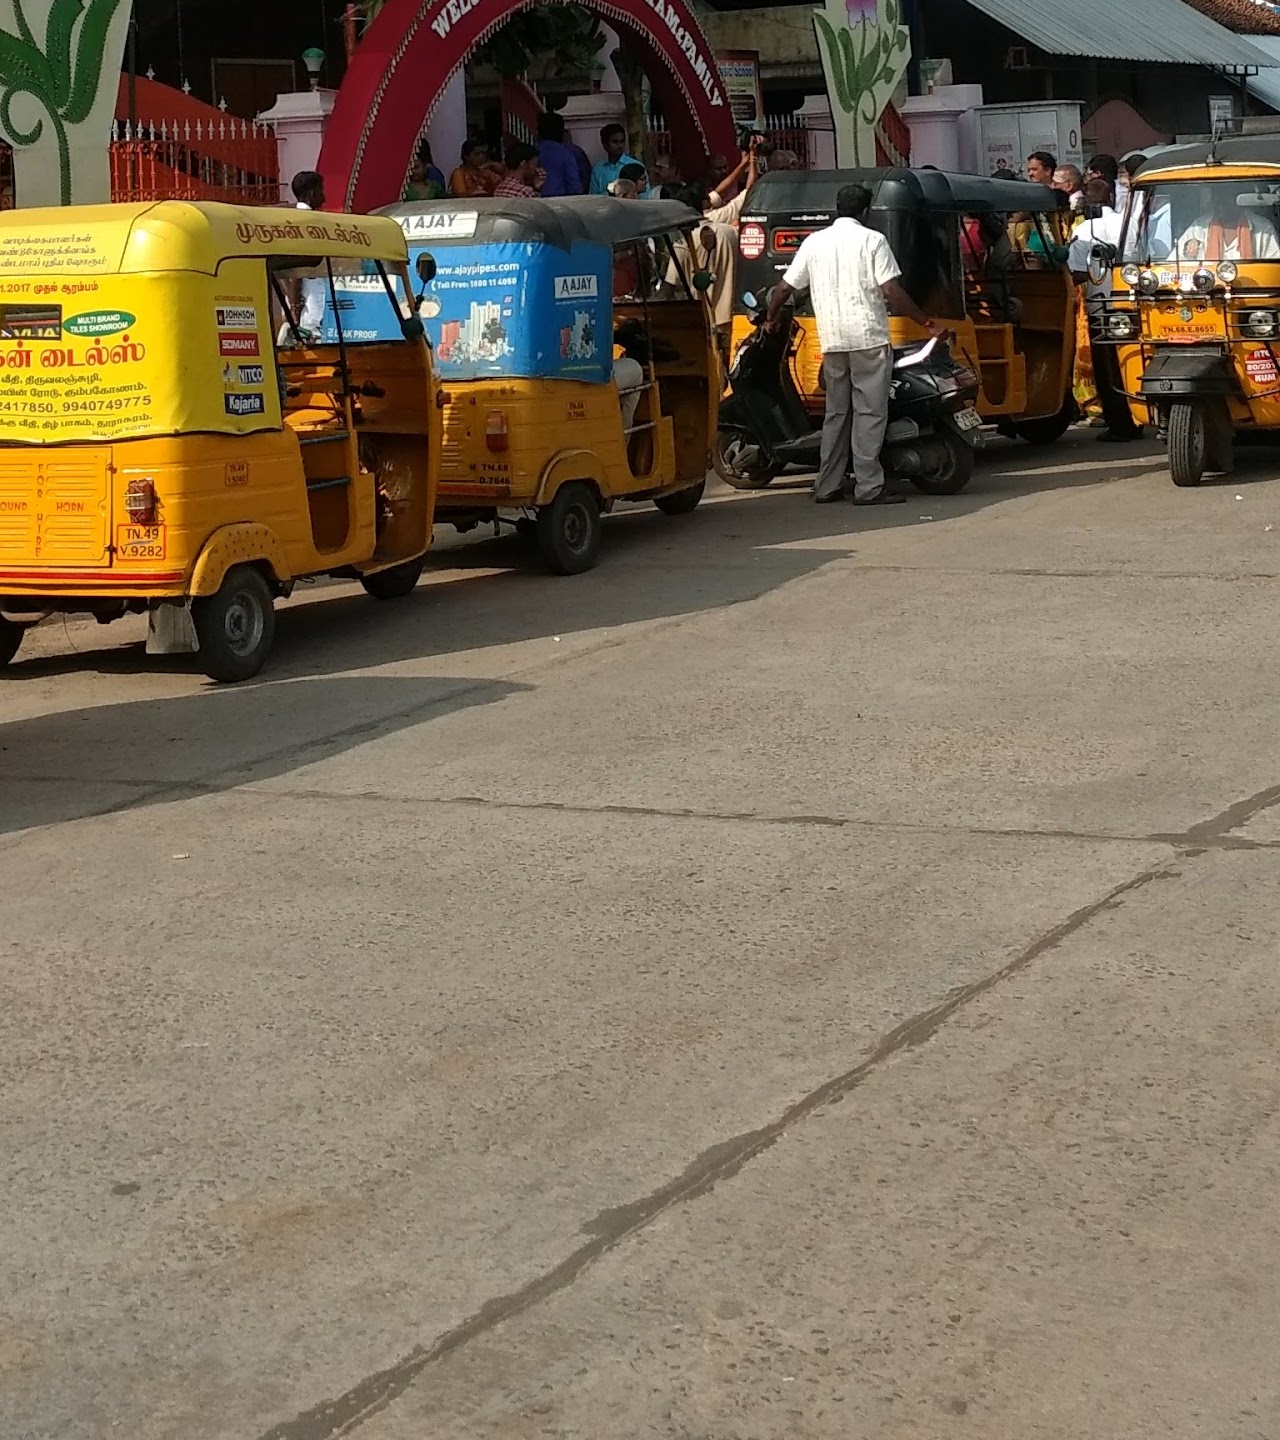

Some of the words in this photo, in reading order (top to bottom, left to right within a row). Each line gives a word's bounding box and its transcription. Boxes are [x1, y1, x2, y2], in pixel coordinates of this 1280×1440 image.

[414, 214, 458, 230] AJAY
[236, 220, 304, 244] முருகன்
[305, 224, 372, 247] டைல்ஸ்
[436, 263, 520, 276] ww.ajaypipes.com
[34, 281, 58, 294] முதல்
[60, 280, 99, 294] ஆரம்பம்
[437, 281, 450, 290] Toll
[570, 277, 592, 291] AJAY
[77, 315, 96, 324] MULTI
[97, 314, 121, 323] BRAND
[225, 309, 255, 320] JOHNSON
[70, 324, 88, 333] TILES
[89, 322, 128, 332] SHOWROOM
[334, 329, 354, 339] LAK
[354, 330, 378, 339] PROOF
[40, 334, 146, 368] டைல்ஸ்
[222, 339, 256, 350] SOMANY
[238, 367, 264, 383] NITCO
[62, 395, 152, 412] 9940749775
[229, 394, 261, 414] Kajaria
[56, 502, 84, 512] HORN
[126, 528, 160, 540] TN.49
[120, 545, 163, 558] V.9282
